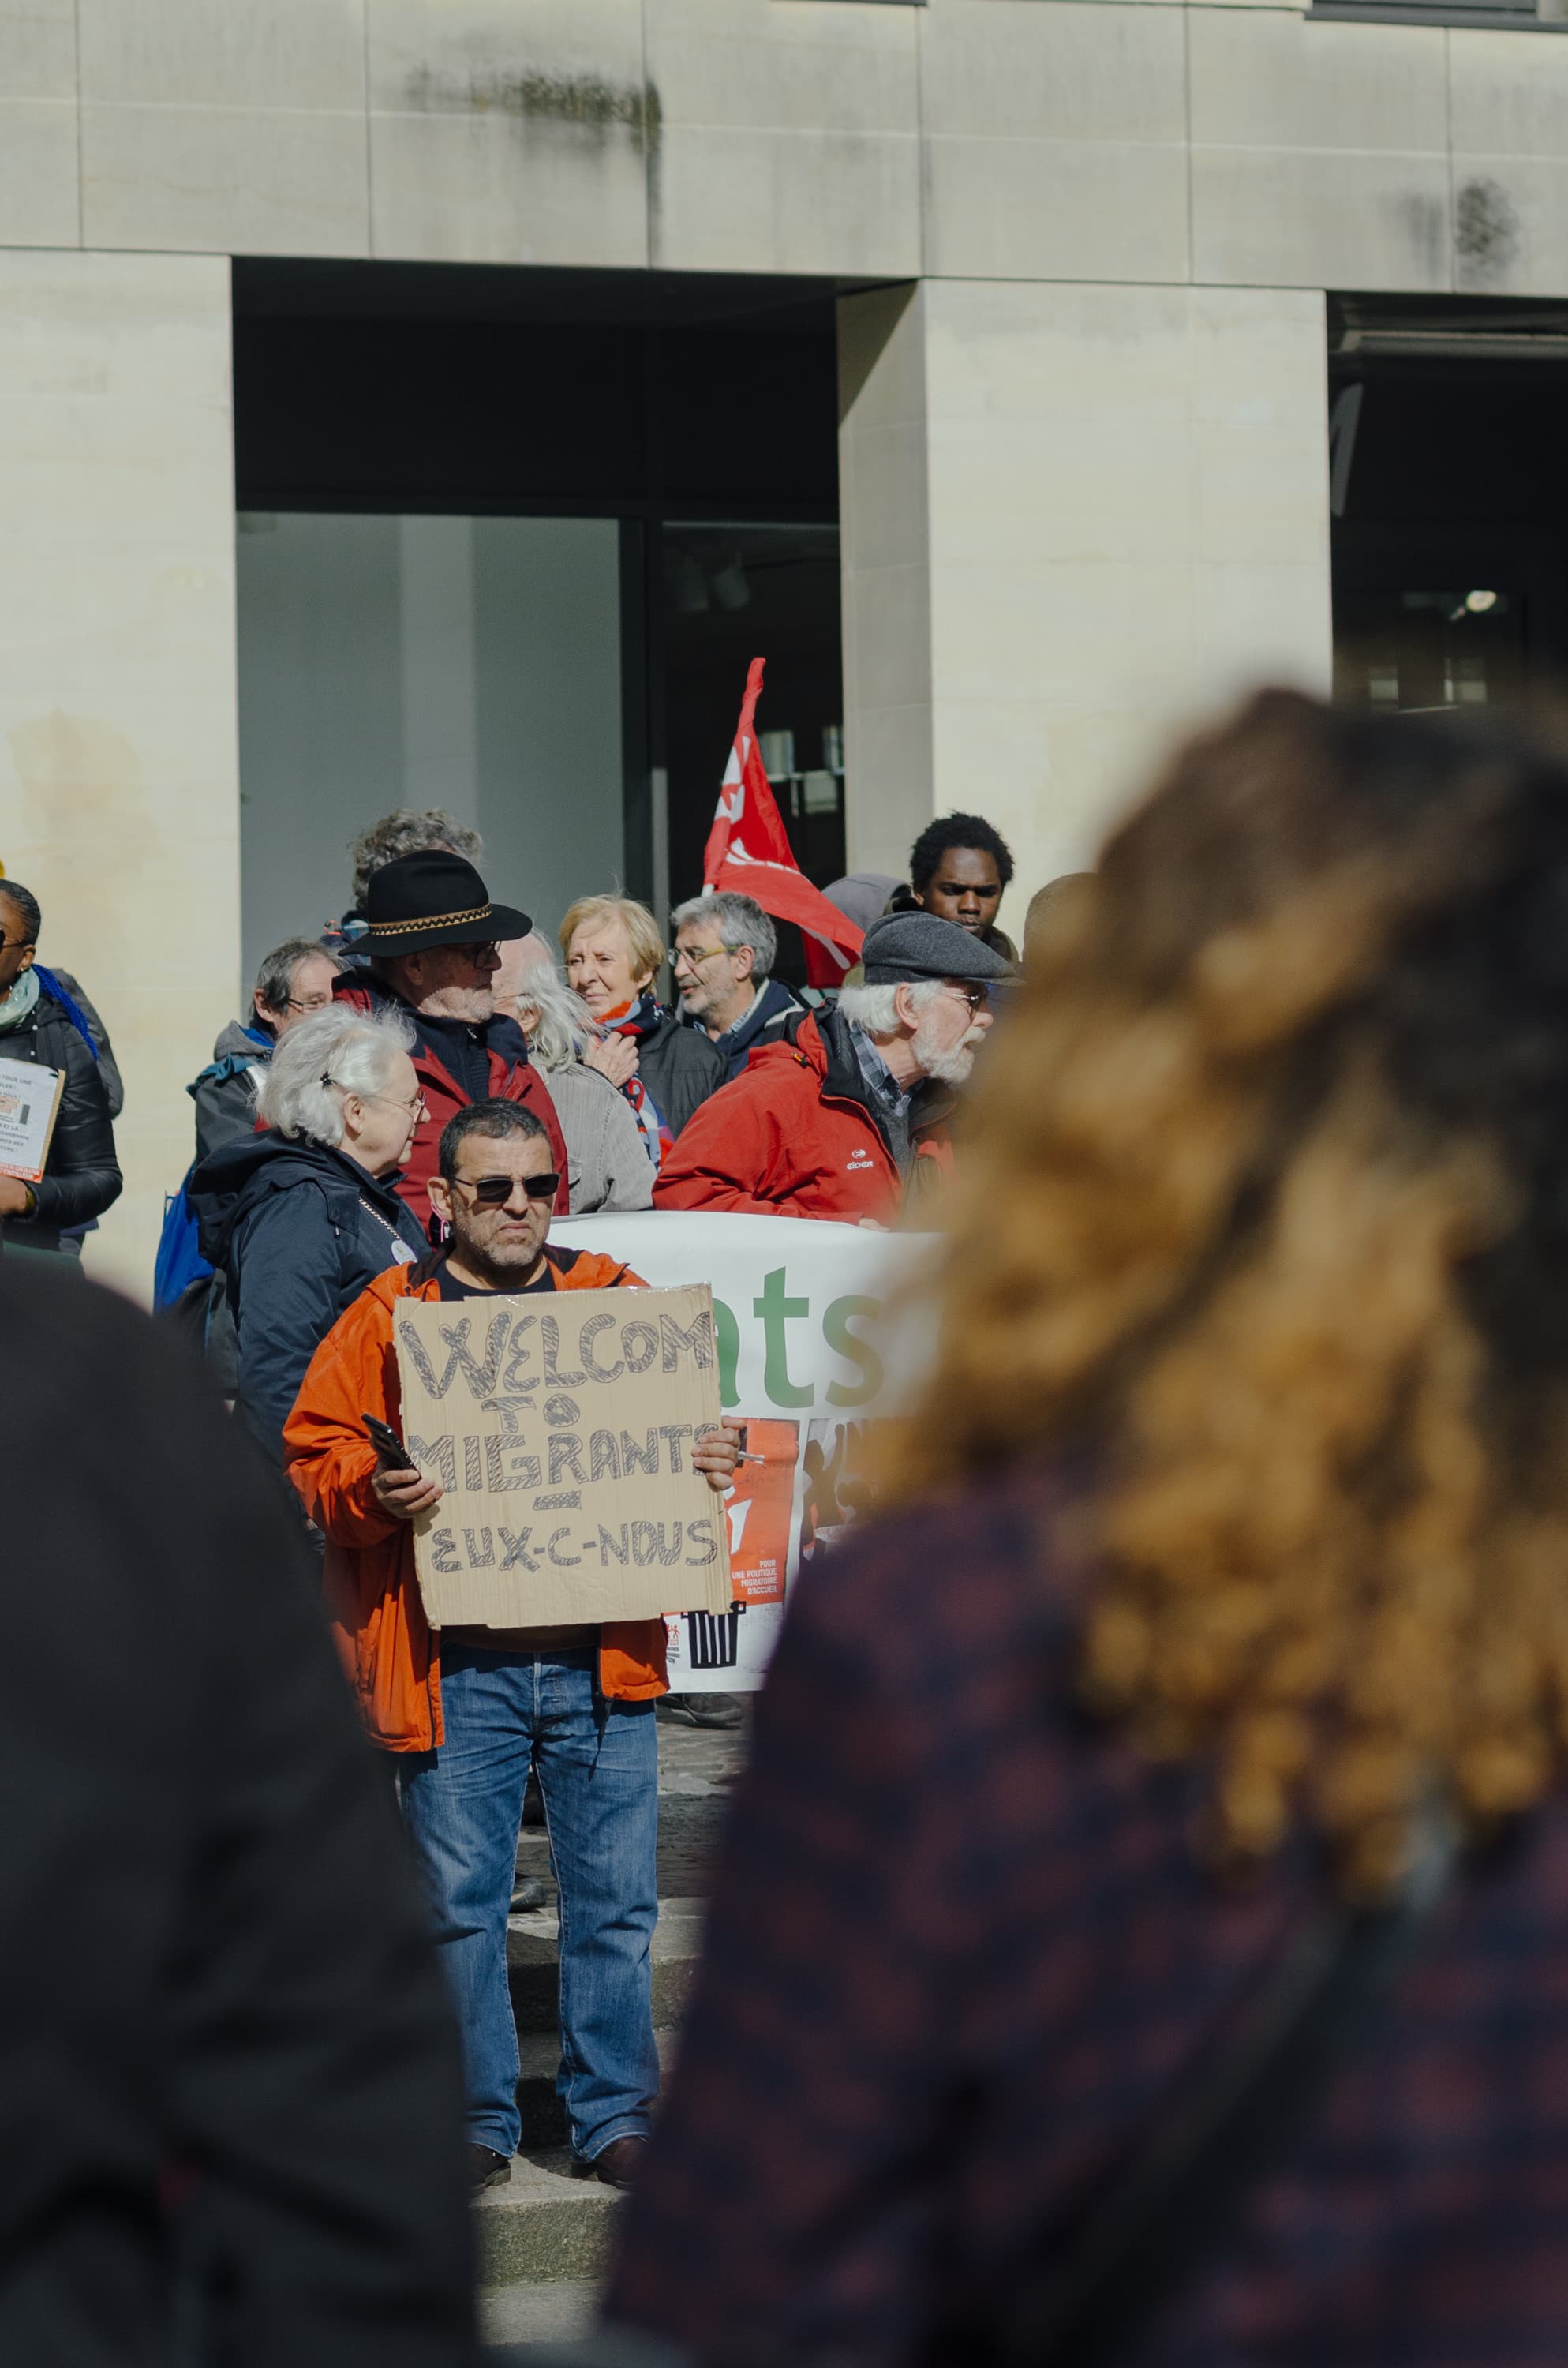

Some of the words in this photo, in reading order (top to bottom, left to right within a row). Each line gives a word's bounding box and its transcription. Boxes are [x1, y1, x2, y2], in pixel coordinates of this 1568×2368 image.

[399, 1311, 713, 1399] WELCOM
[481, 1393, 581, 1433] TO
[759, 1559, 776, 1568] POUR
[732, 1571, 745, 1579] UNE
[747, 1568, 777, 1578] POLITIQUE
[741, 1576, 777, 1587] MIGRATOIRE
[747, 1586, 777, 1594] D'ACCUEIL
